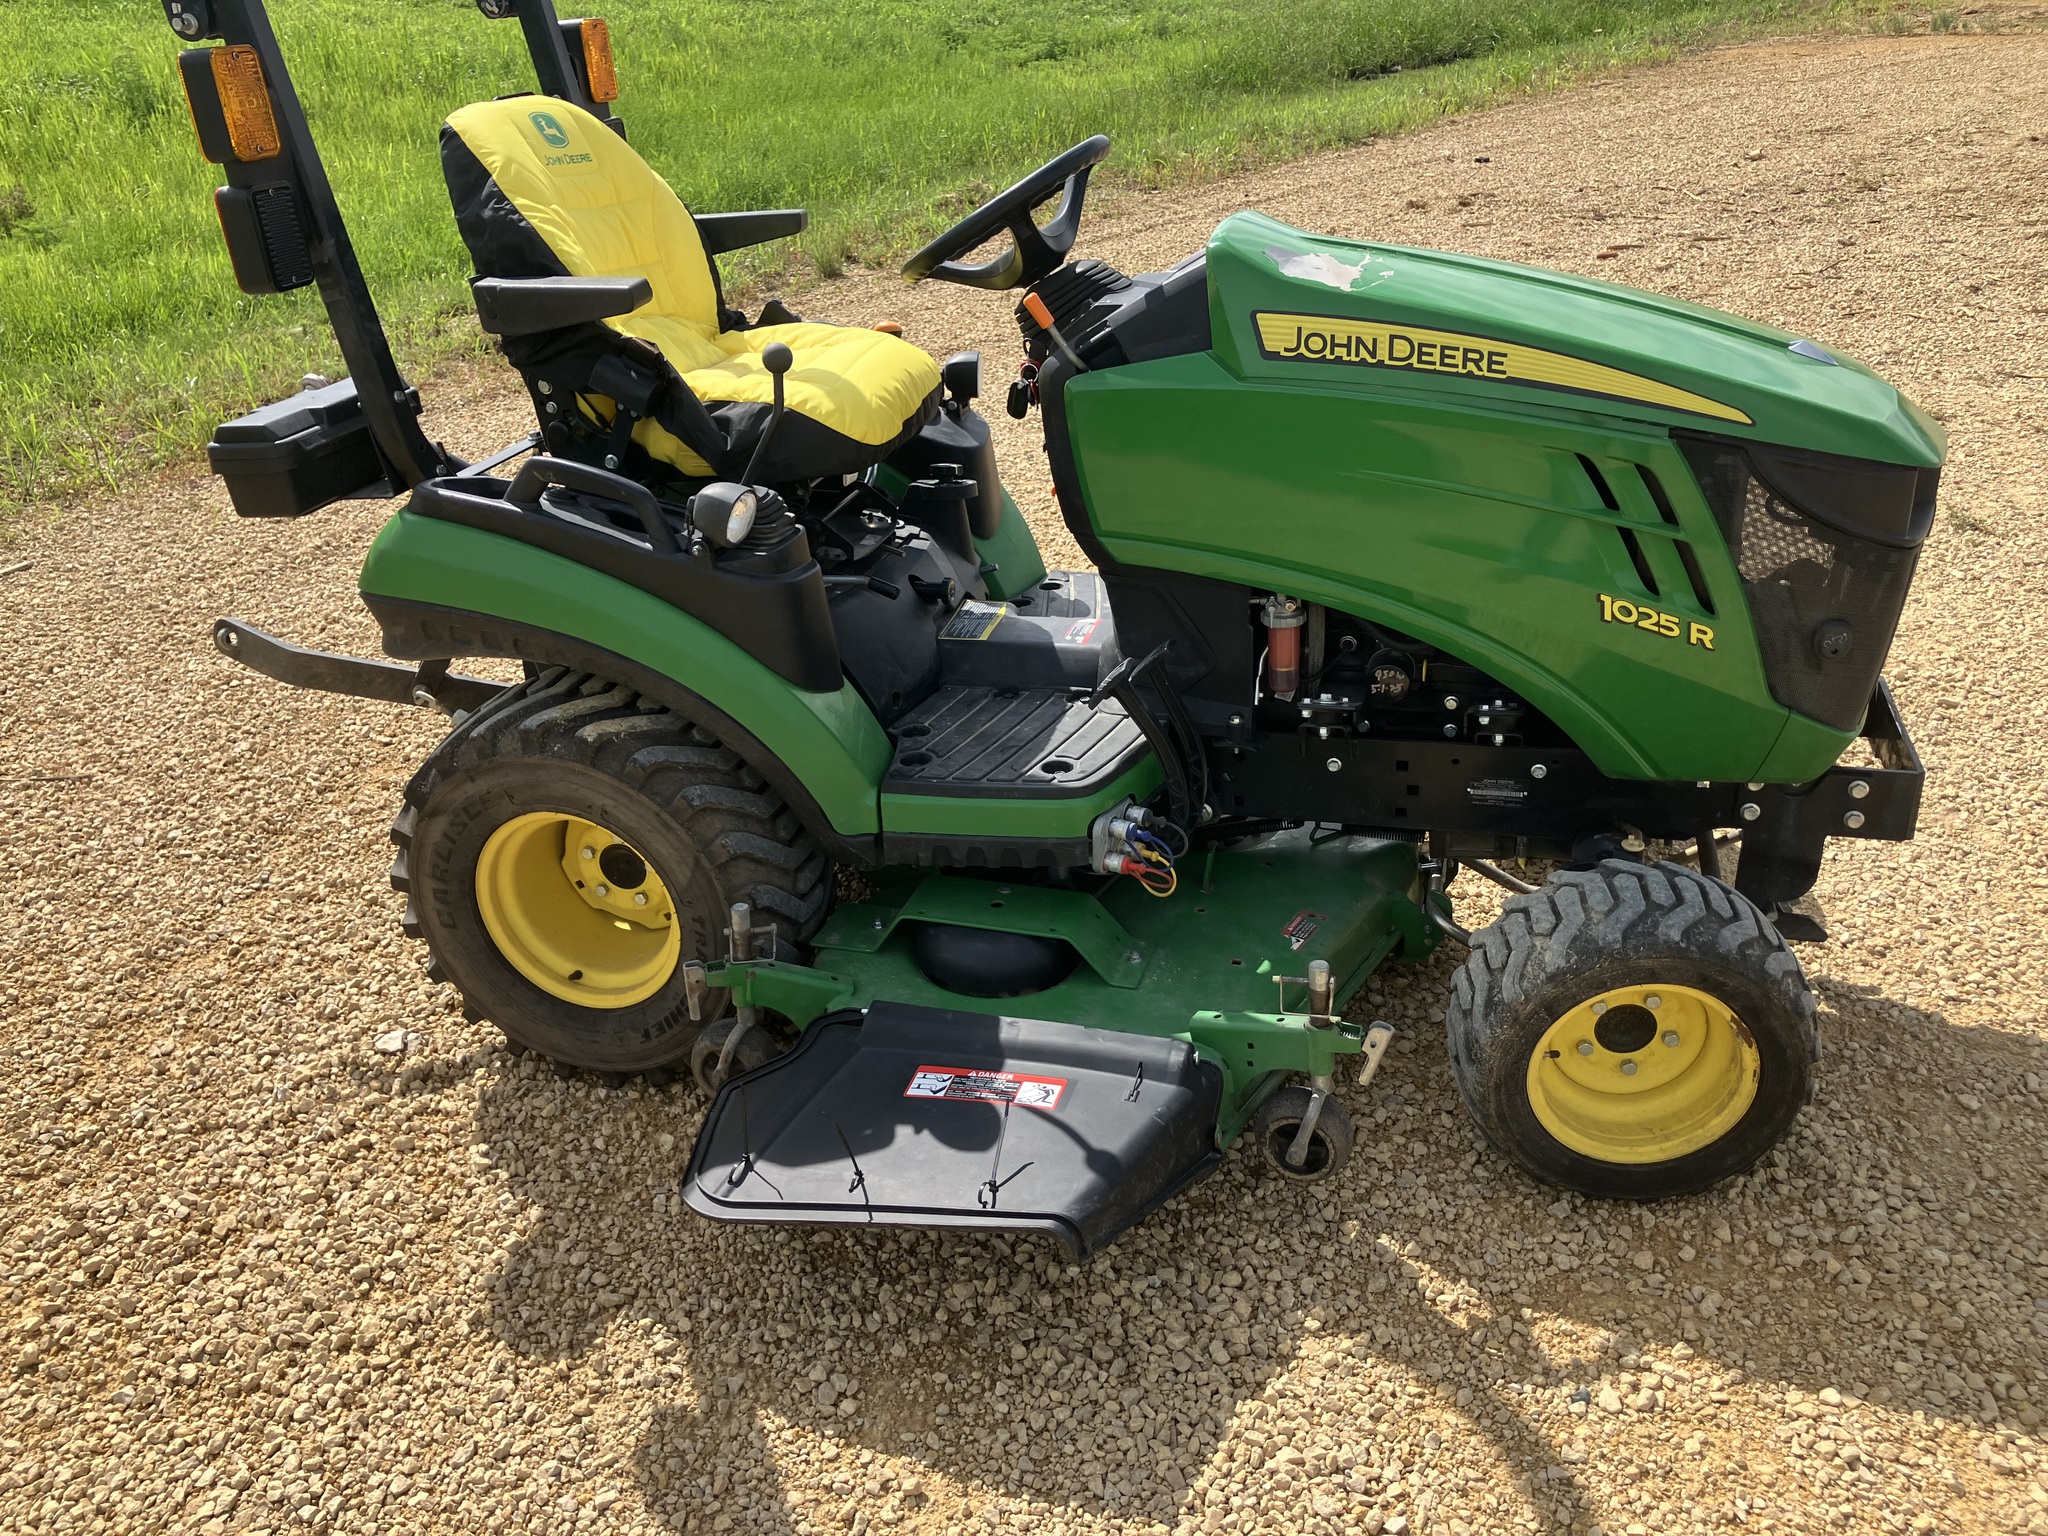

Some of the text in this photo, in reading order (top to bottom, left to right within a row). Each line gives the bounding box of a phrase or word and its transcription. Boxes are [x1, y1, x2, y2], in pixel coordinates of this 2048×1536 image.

[544, 152, 593, 167] JOHN DEERE
[1283, 326, 1508, 375] JOHN DEERE
[1599, 593, 1715, 650] 1025 R
[1375, 669, 1395, 681] 950
[431, 787, 501, 931] CARLISLE
[977, 1071, 1014, 1080] DANGER
